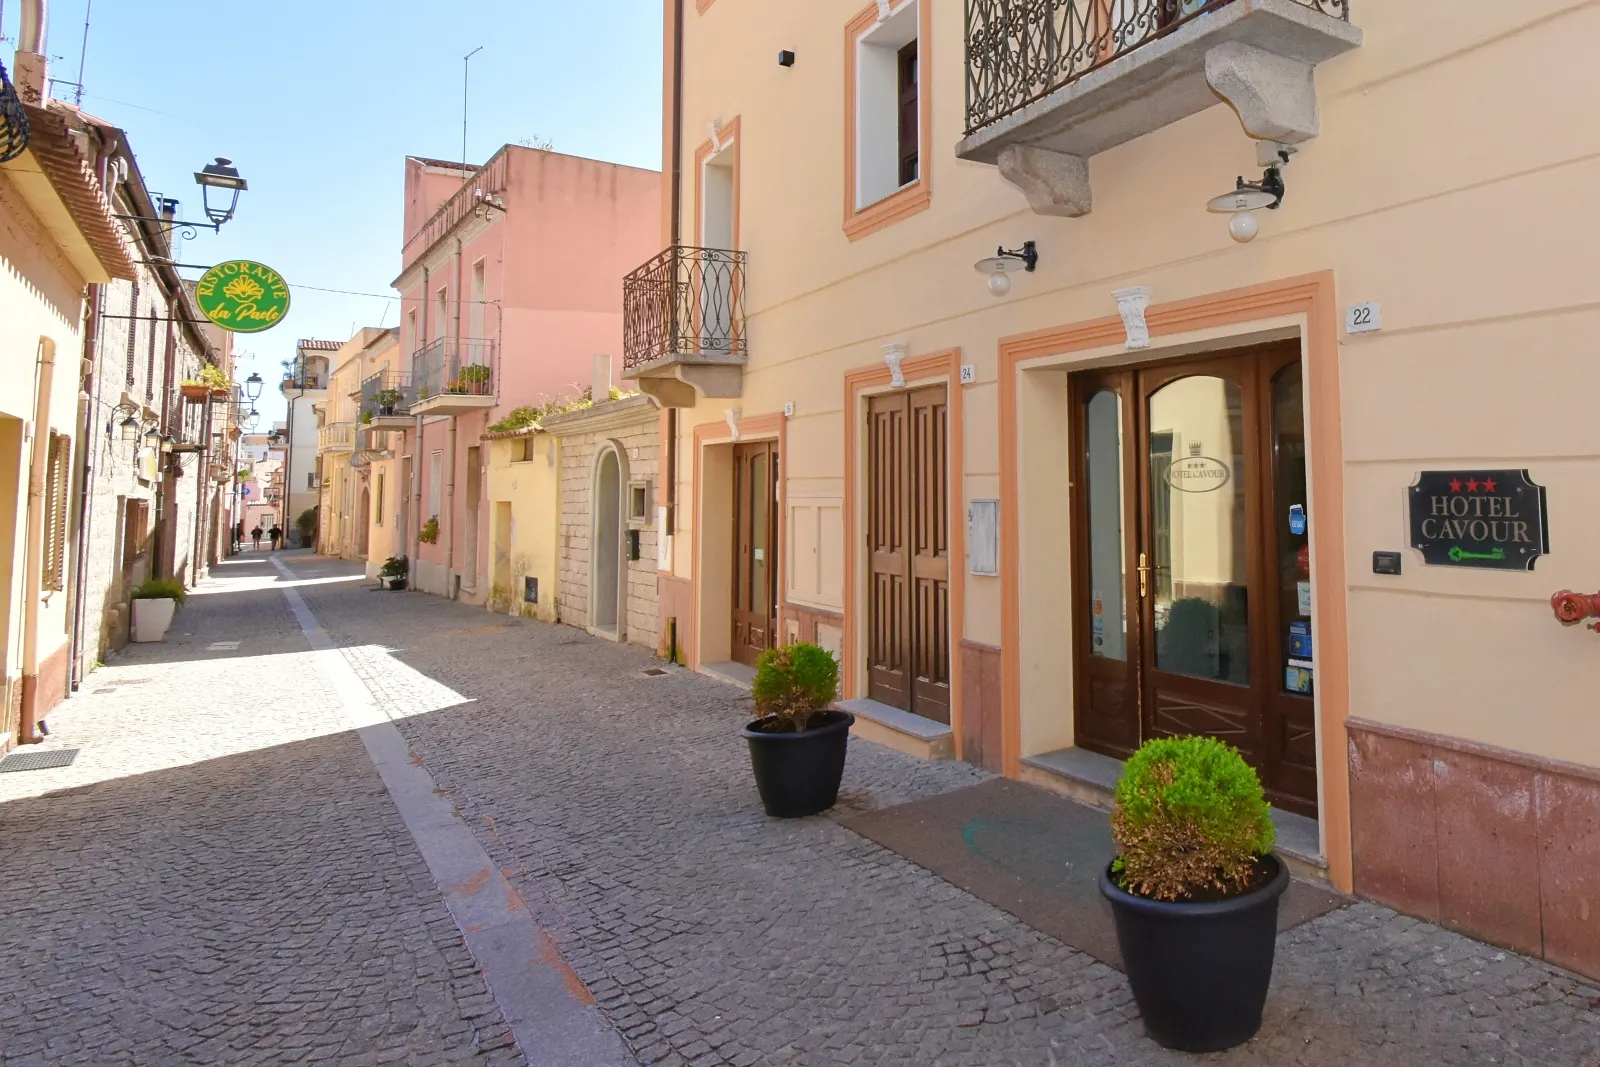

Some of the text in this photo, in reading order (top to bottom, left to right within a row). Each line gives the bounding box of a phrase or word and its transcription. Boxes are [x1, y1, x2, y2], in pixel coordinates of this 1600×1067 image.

[199, 262, 287, 299] RISTORANTE
[208, 302, 280, 322] da Paolo
[1353, 307, 1371, 326] 22
[962, 367, 971, 380] 24
[1193, 469, 1225, 479] CAVOUR
[1430, 495, 1520, 518] HOTEL
[1421, 518, 1532, 544] CAVOUR
